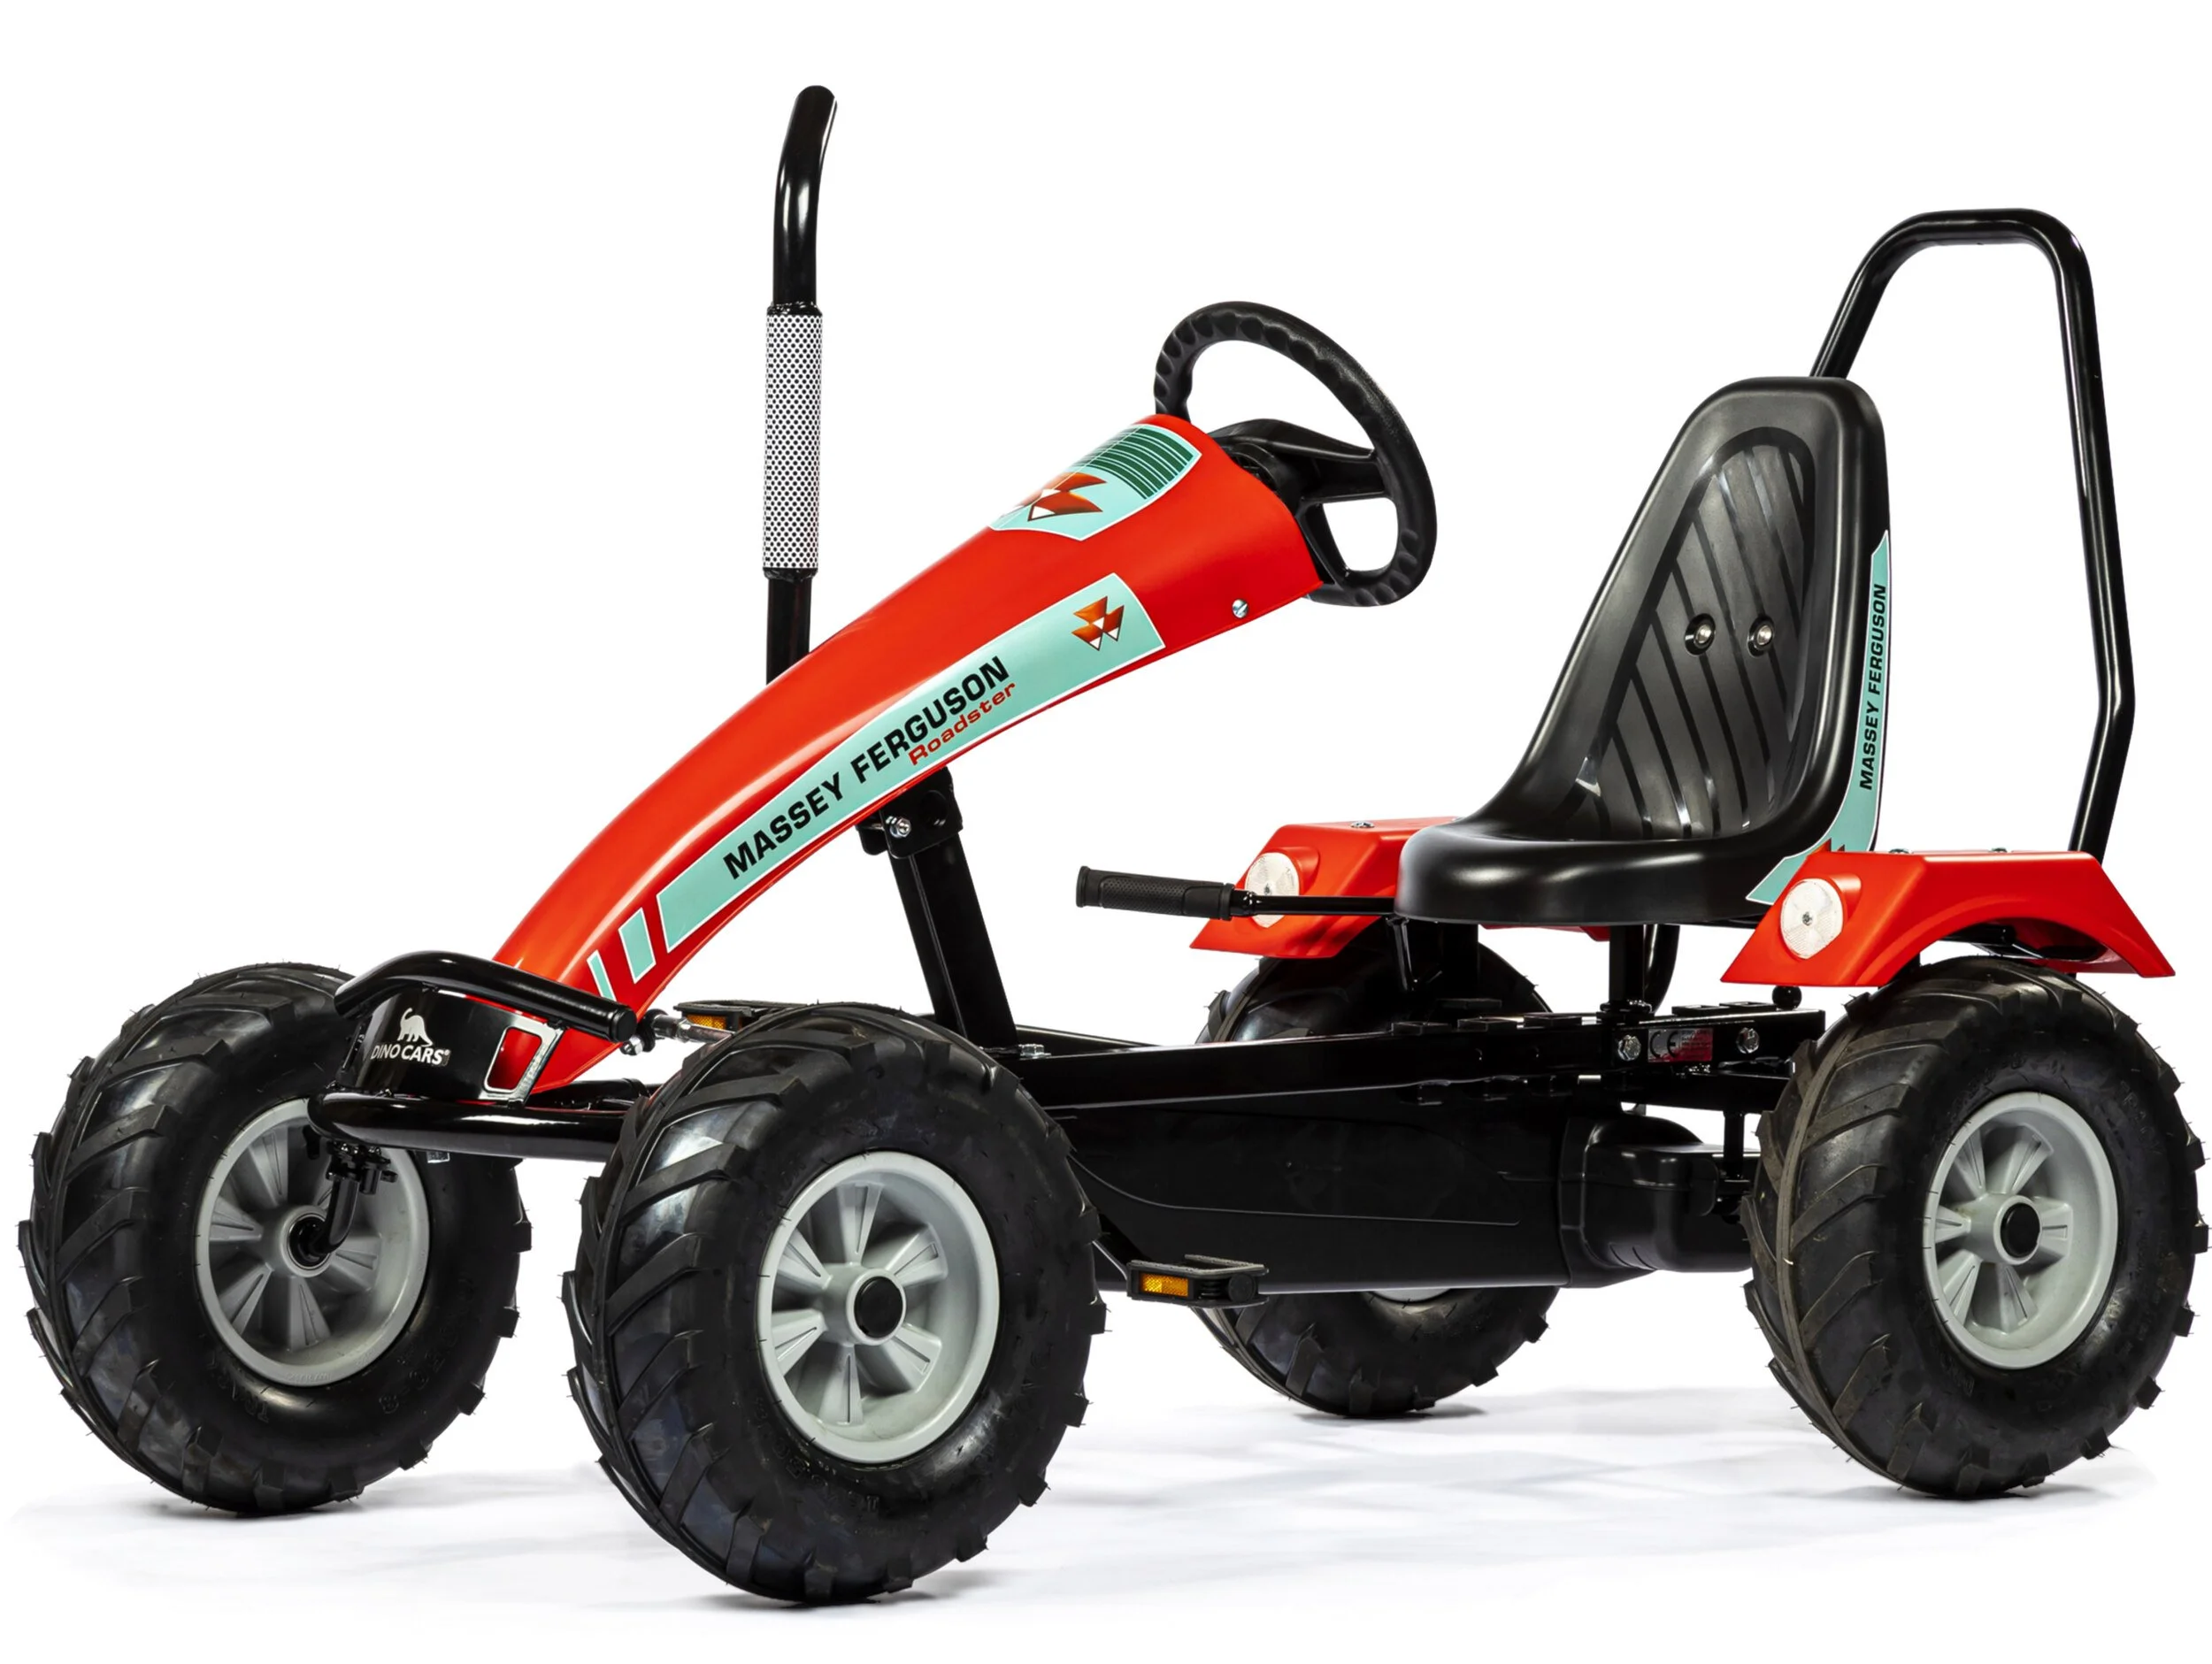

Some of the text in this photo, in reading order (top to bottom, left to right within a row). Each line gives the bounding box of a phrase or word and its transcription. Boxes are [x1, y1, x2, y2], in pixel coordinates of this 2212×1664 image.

[908, 683, 1016, 766] Roadster
[1859, 584, 1886, 791] MASSEY FERGUSON
[723, 656, 1010, 879] MASSEY FERGUSON
[370, 1043, 401, 1060] DINO
